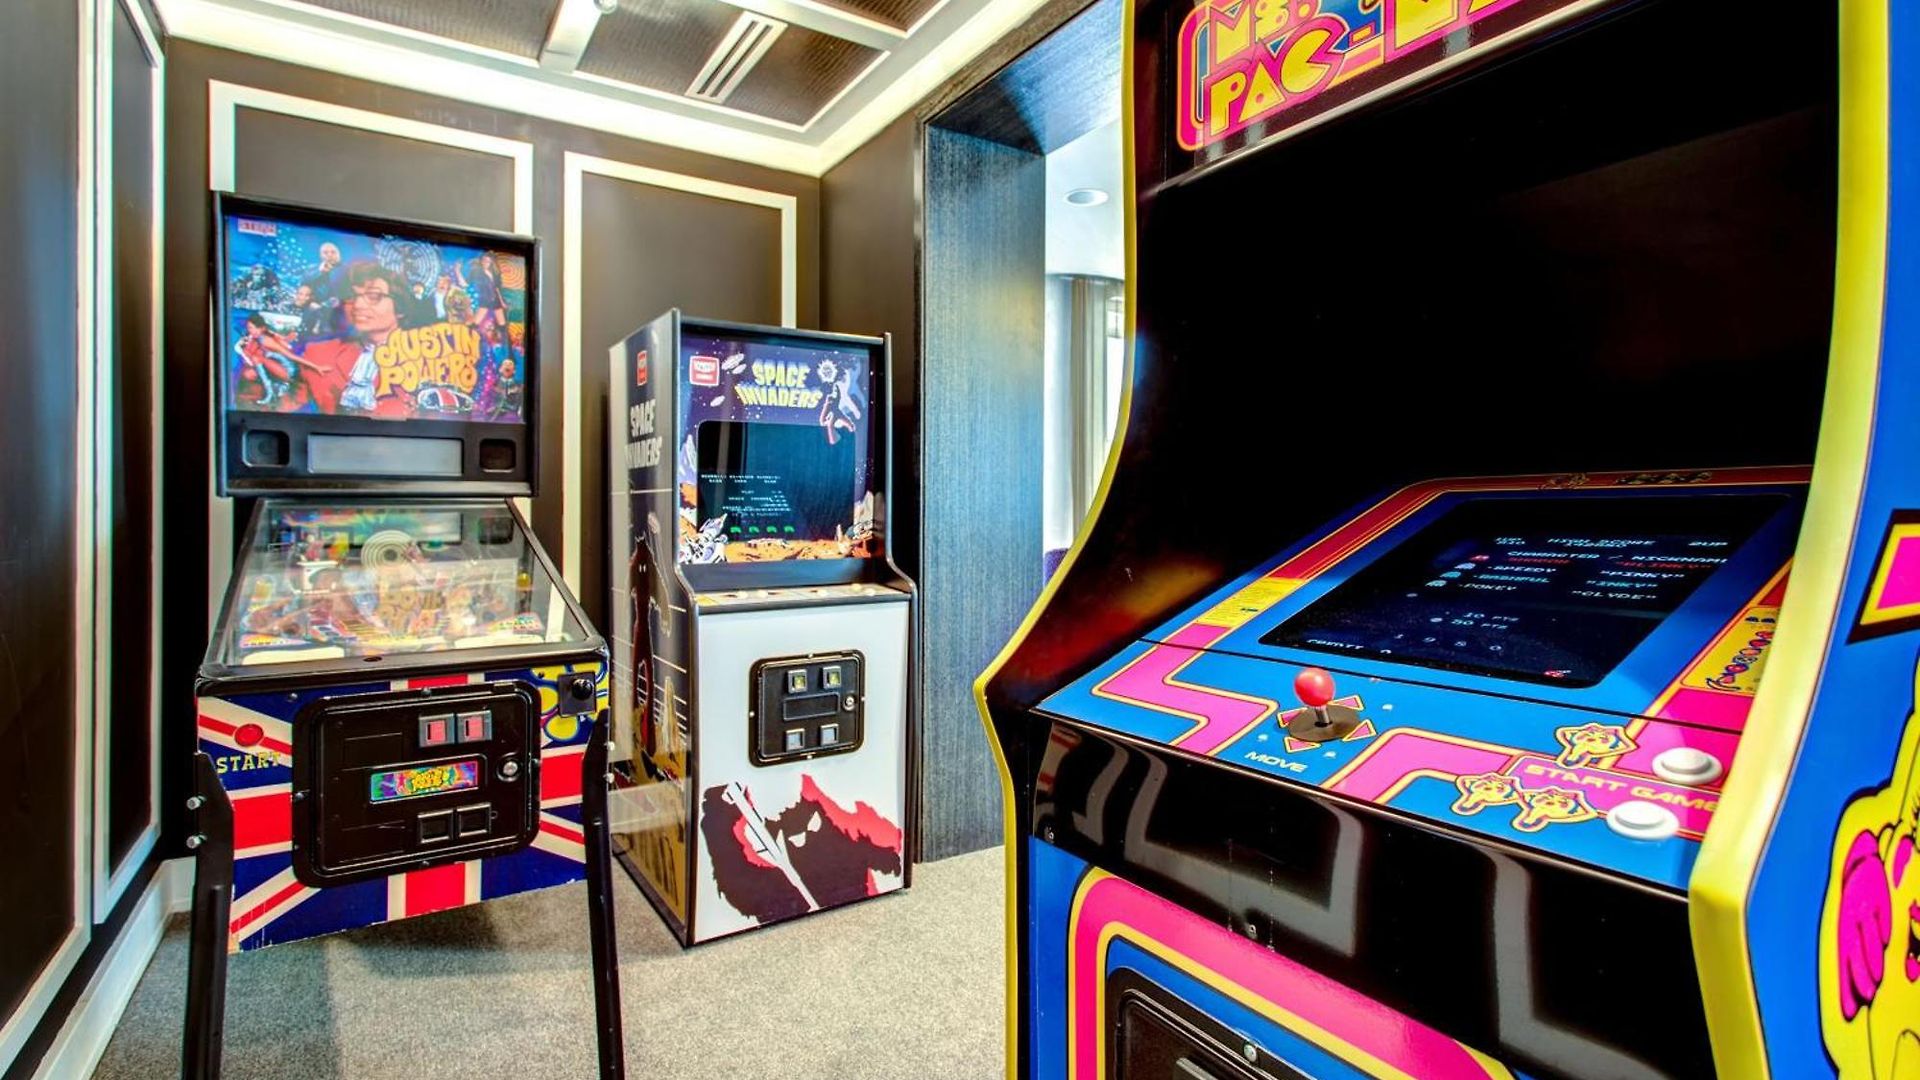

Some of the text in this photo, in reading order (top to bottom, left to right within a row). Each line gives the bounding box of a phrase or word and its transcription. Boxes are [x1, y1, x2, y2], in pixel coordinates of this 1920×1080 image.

[375, 322, 481, 368] AUSTIN
[375, 353, 478, 398] POWERS
[752, 359, 811, 388] SPACE
[734, 383, 823, 409] INVADERS
[631, 399, 656, 437] SPACE
[1507, 550, 1600, 559] CHARACTER
[1631, 555, 1728, 564] NICKNAM
[216, 751, 280, 774] START
[1244, 751, 1308, 773] MOVE
[1524, 764, 1720, 812] START GAME
